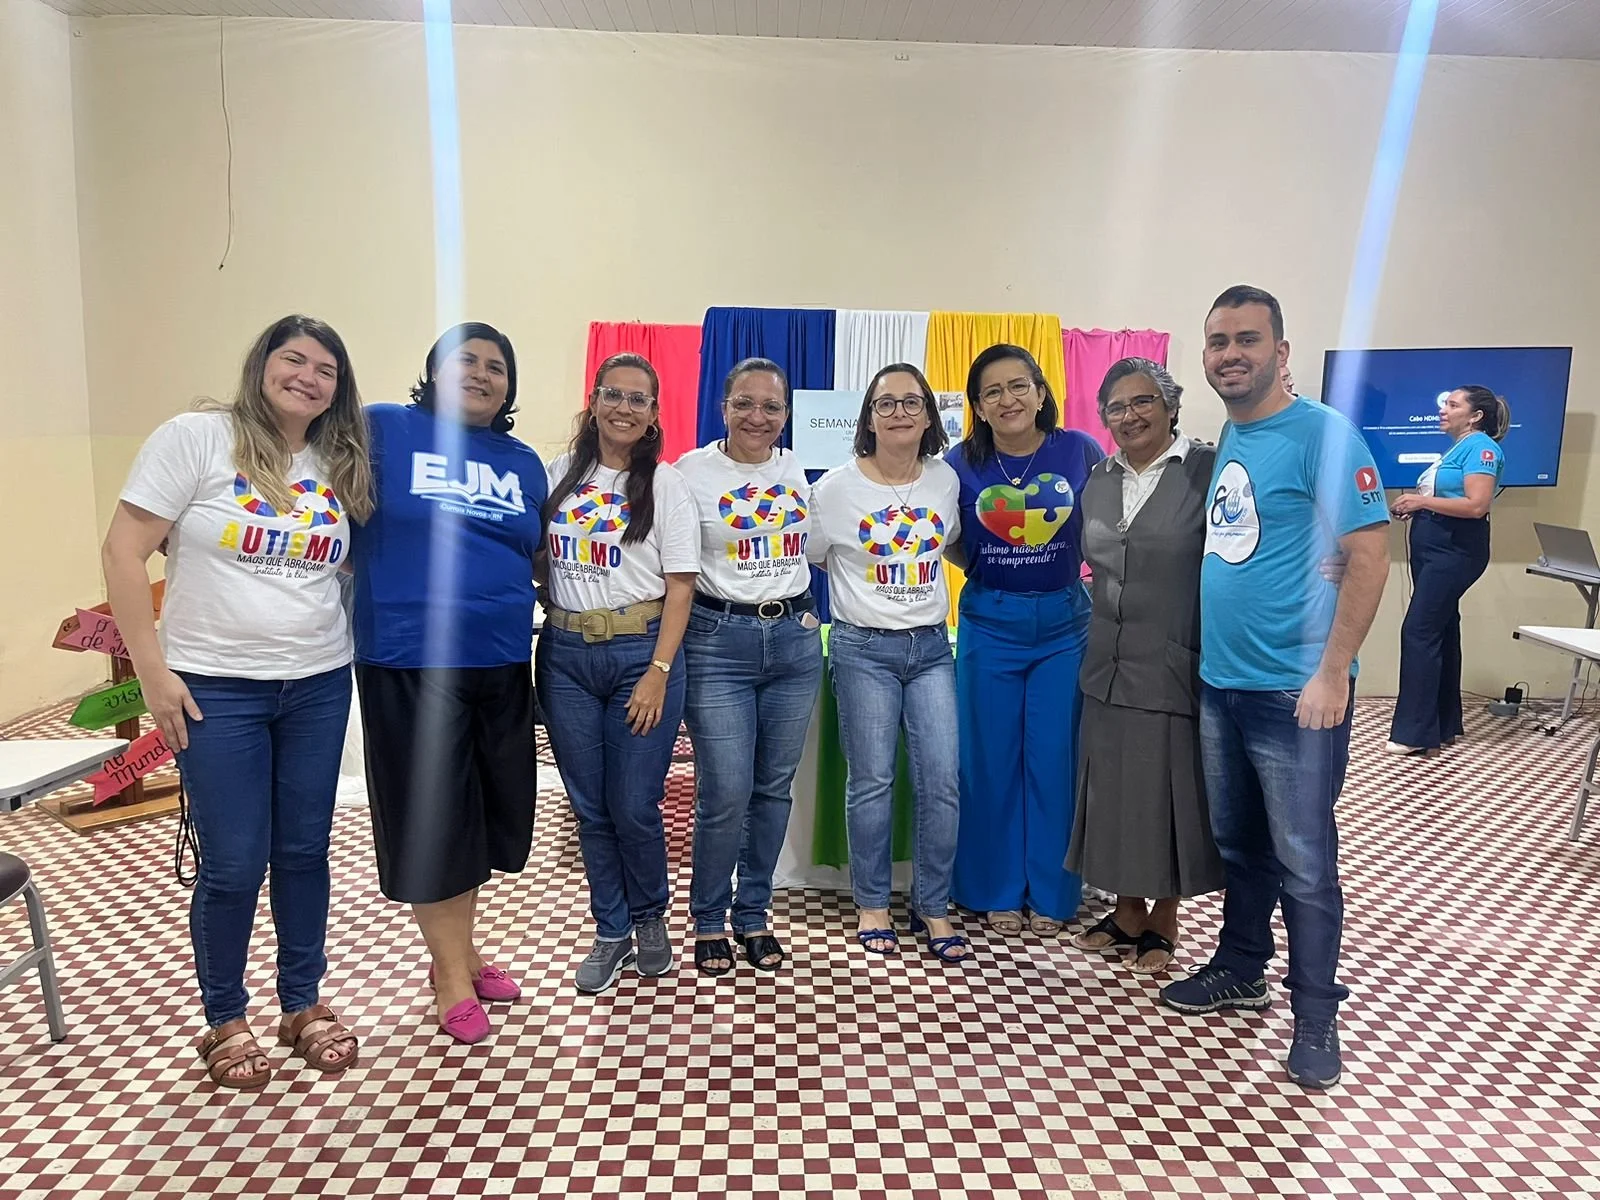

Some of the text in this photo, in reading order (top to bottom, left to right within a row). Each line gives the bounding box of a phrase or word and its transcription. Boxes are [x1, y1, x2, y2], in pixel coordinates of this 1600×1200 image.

[810, 418, 859, 429] SEMANA
[1480, 460, 1494, 468] sm
[411, 451, 525, 510] EJM
[1361, 490, 1384, 505] sm
[217, 520, 343, 564] AUTISMO
[549, 533, 622, 568] UTISMO
[236, 554, 265, 566] MÃOS
[265, 556, 282, 567] QUE
[737, 561, 757, 571] MÃOS
[758, 560, 771, 569] QUE
[864, 560, 939, 585] AUTISMO
[109, 737, 172, 785] Mund
